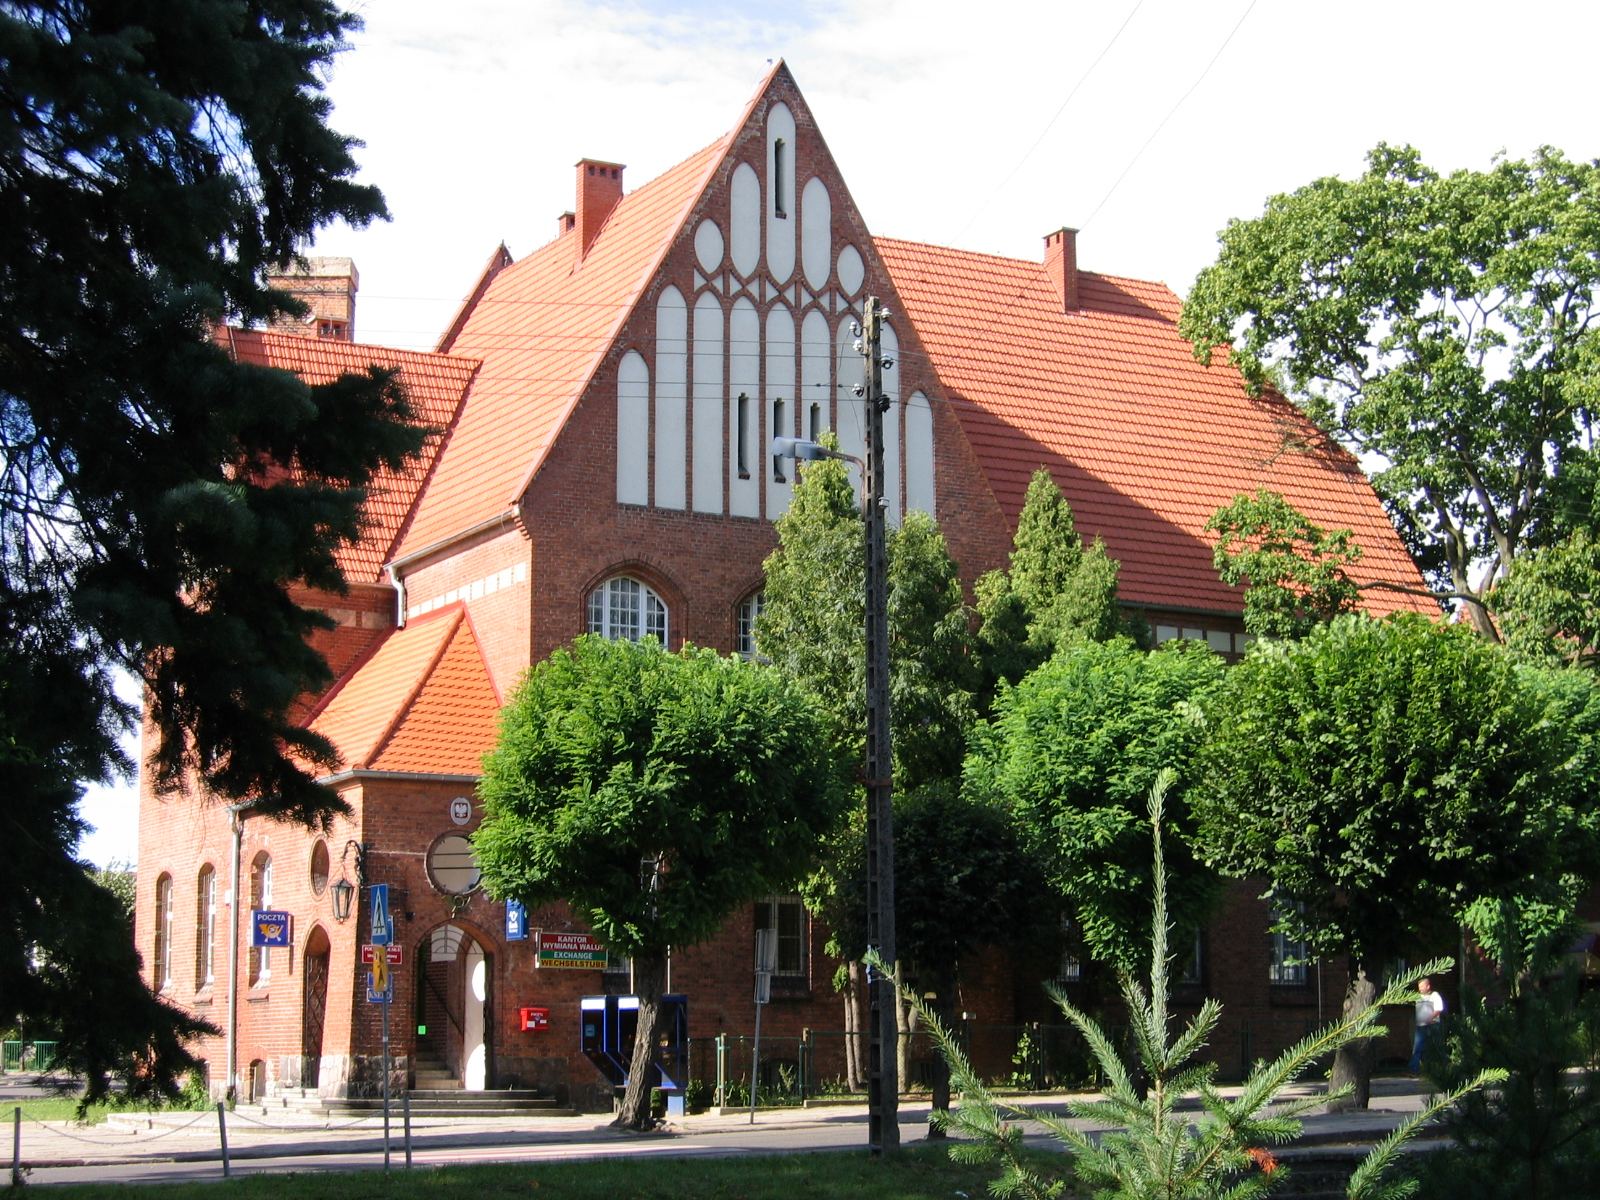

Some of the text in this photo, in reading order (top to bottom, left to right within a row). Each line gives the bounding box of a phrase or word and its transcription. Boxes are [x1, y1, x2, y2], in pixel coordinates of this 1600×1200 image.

[257, 913, 286, 921] POCZTA
[557, 935, 587, 943] KANTOR
[543, 942, 578, 950] WYMIANA
[553, 951, 593, 959] EXCHANGE
[541, 959, 606, 968] WECHSELSTUBE
